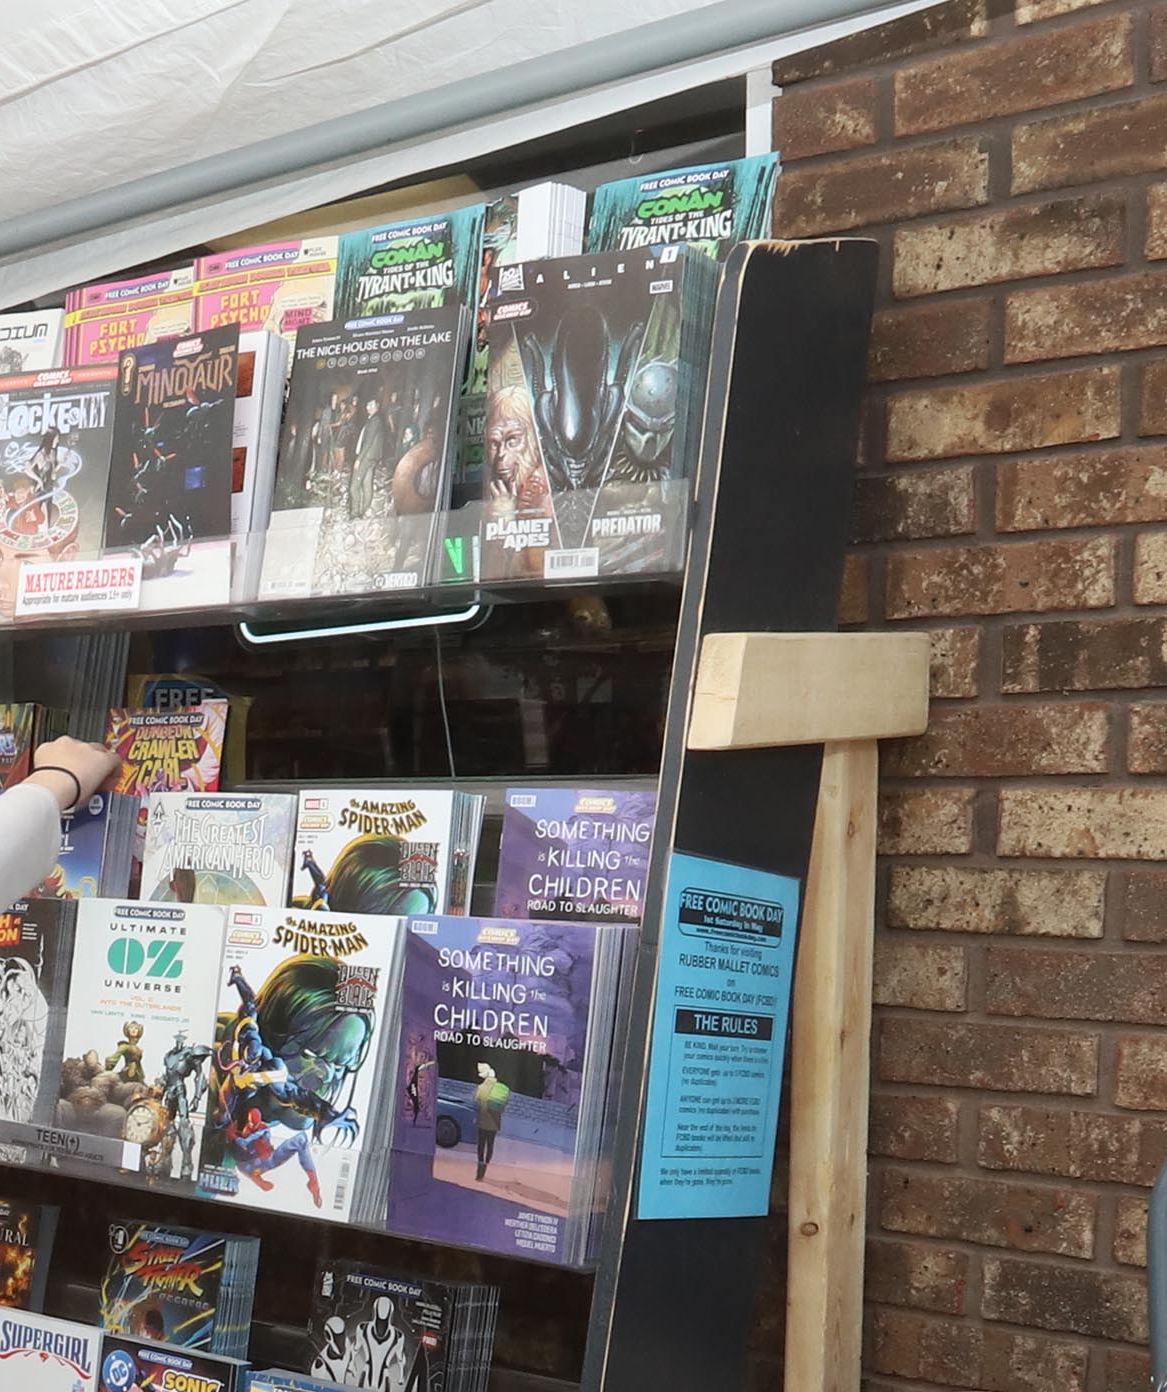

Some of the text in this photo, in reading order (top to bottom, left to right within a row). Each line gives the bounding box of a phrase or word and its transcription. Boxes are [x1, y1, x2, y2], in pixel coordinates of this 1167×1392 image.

[640, 169, 729, 192] FREE COMIC BOOK DAY
[637, 189, 723, 219] CONAN
[650, 211, 704, 225] TIDES OF THE
[371, 222, 448, 242] FREE COMIC BOOK DAY
[371, 241, 444, 268] CONAN
[383, 261, 429, 274] TIDES OF THE
[220, 290, 259, 309] FORT
[100, 318, 137, 336] FORT
[210, 305, 270, 329] PSYCHO
[89, 332, 146, 356] PSYCHO
[297, 347, 316, 360] THE
[317, 344, 341, 357] NICE
[342, 340, 379, 355] HOUSE
[380, 338, 397, 350] ON
[400, 335, 421, 346] THE
[422, 331, 452, 345] LAKE
[135, 354, 233, 405] MINOTAUR
[591, 514, 662, 537] PREDATOR
[25, 567, 135, 593] MATURE READERS
[128, 739, 200, 761] CRAWLER
[247, 801, 262, 809] DAY
[535, 819, 650, 843] SOMETHING
[538, 846, 641, 870] is KILLING the
[528, 874, 641, 901] CHILDREN
[114, 908, 186, 920] FREE COMIC BOOK DAY
[527, 900, 639, 916] ROAD TO SLAUGHTER
[680, 893, 784, 923] FREE COMIC BOOK DAY
[109, 922, 187, 936] ULTIMATE
[715, 917, 742, 930] Saturday
[751, 922, 763, 934] May
[106, 937, 184, 979] OZ
[438, 947, 555, 977] SOMETHING
[705, 941, 762, 961] Thanks for visiting
[679, 953, 779, 978] RUBBER MALLET COMICS
[104, 980, 182, 994] UNIVERSE
[442, 976, 547, 1004] is KILLING the
[727, 979, 735, 987] on
[434, 1003, 548, 1038] CHILDREN
[694, 1014, 758, 1034] THE RULES
[434, 1030, 547, 1053] ROAD TO SLAUGHTER
[0, 1320, 93, 1373] SUPERGIRL
